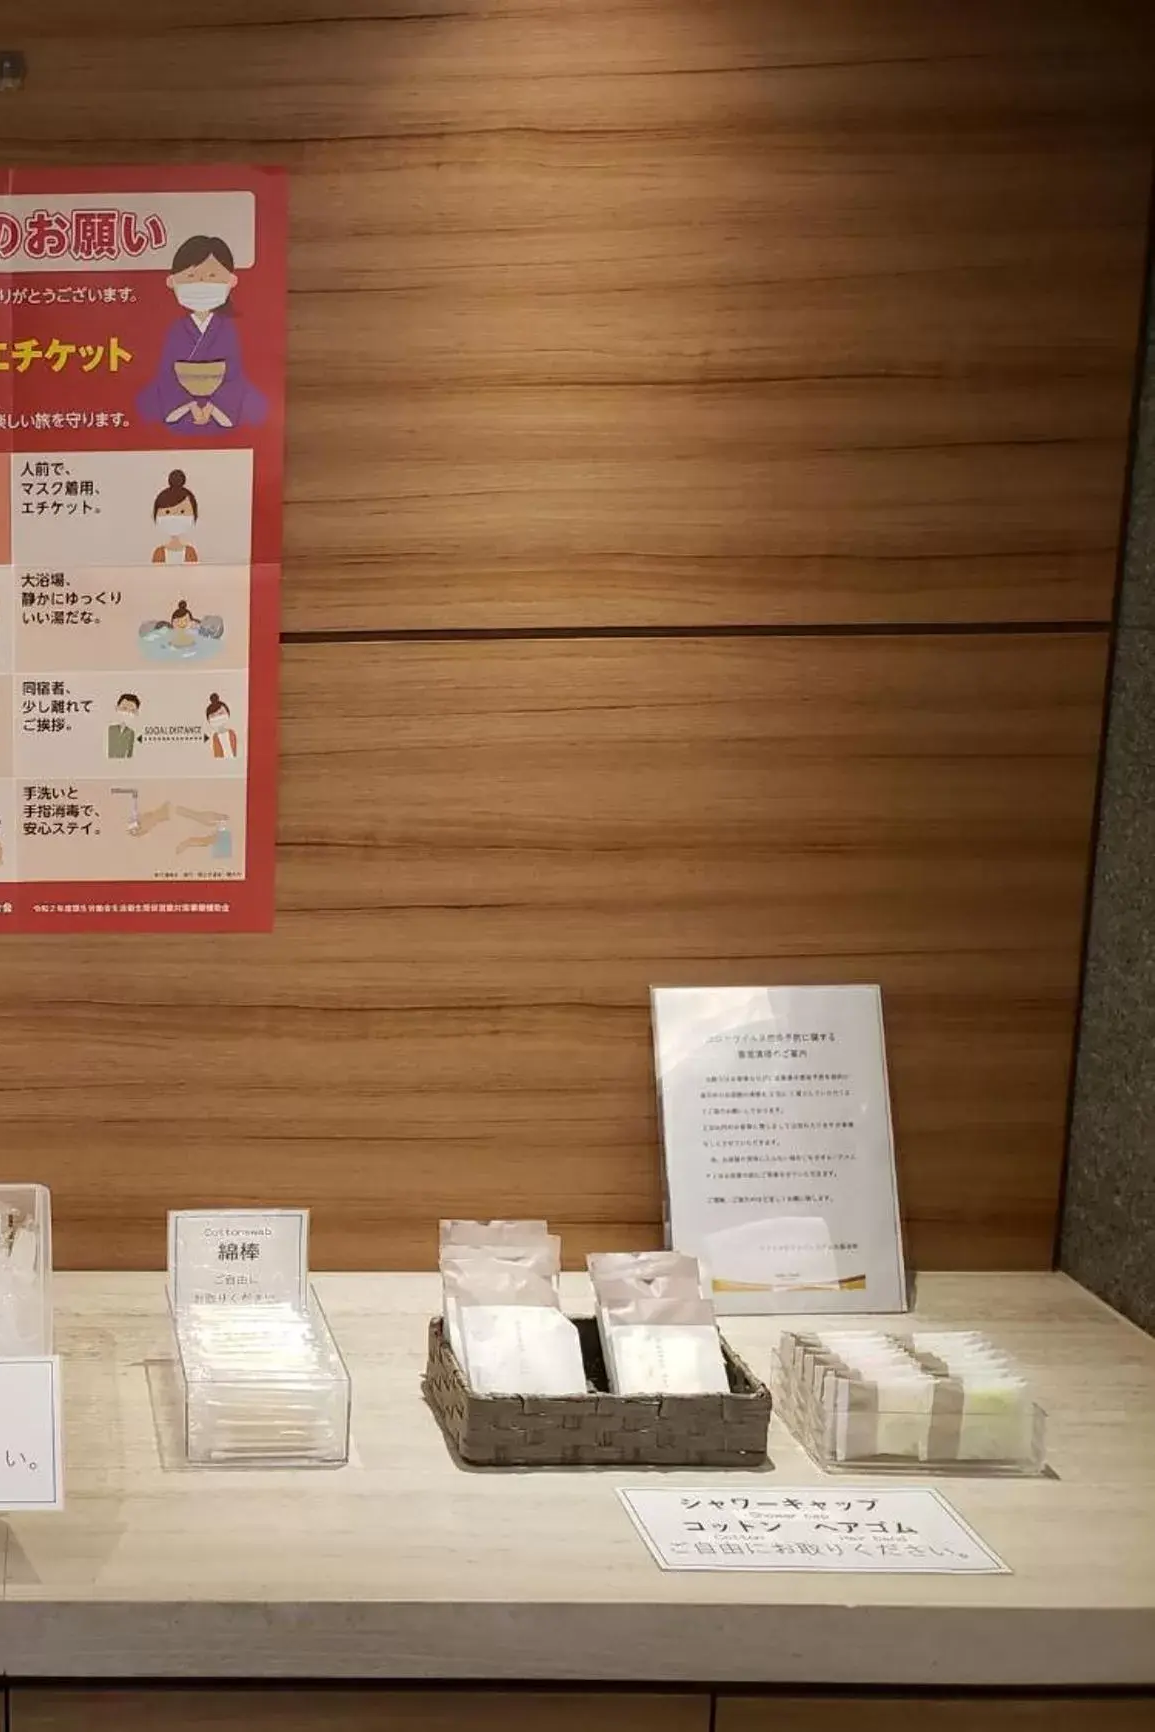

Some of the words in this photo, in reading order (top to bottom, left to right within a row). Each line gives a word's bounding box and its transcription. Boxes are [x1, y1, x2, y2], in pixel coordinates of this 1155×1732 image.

[20, 461, 72, 477] 人前で、
[21, 480, 101, 496] マスク着用、
[21, 501, 102, 515] エチケット。
[21, 572, 72, 588] 大浴場、
[21, 591, 123, 607] 静かにゆっくり
[21, 610, 102, 625] いい湯だな。
[22, 681, 72, 697] 同宿者、
[22, 700, 93, 715] 少し離れて
[22, 717, 73, 733] ご挨拶。
[23, 785, 79, 801] 手洗いと
[23, 804, 101, 819] 手指消毒で、
[23, 821, 102, 836] 安心ステイ。
[217, 1242, 261, 1261] 綿棒
[214, 1274, 259, 1286] ご自由に
[680, 1496, 880, 1511] シャワーキャップ
[682, 1520, 782, 1533] コットン
[813, 1520, 919, 1535] ヘアゴム
[669, 1541, 972, 1561] ご自由にお取りください。
